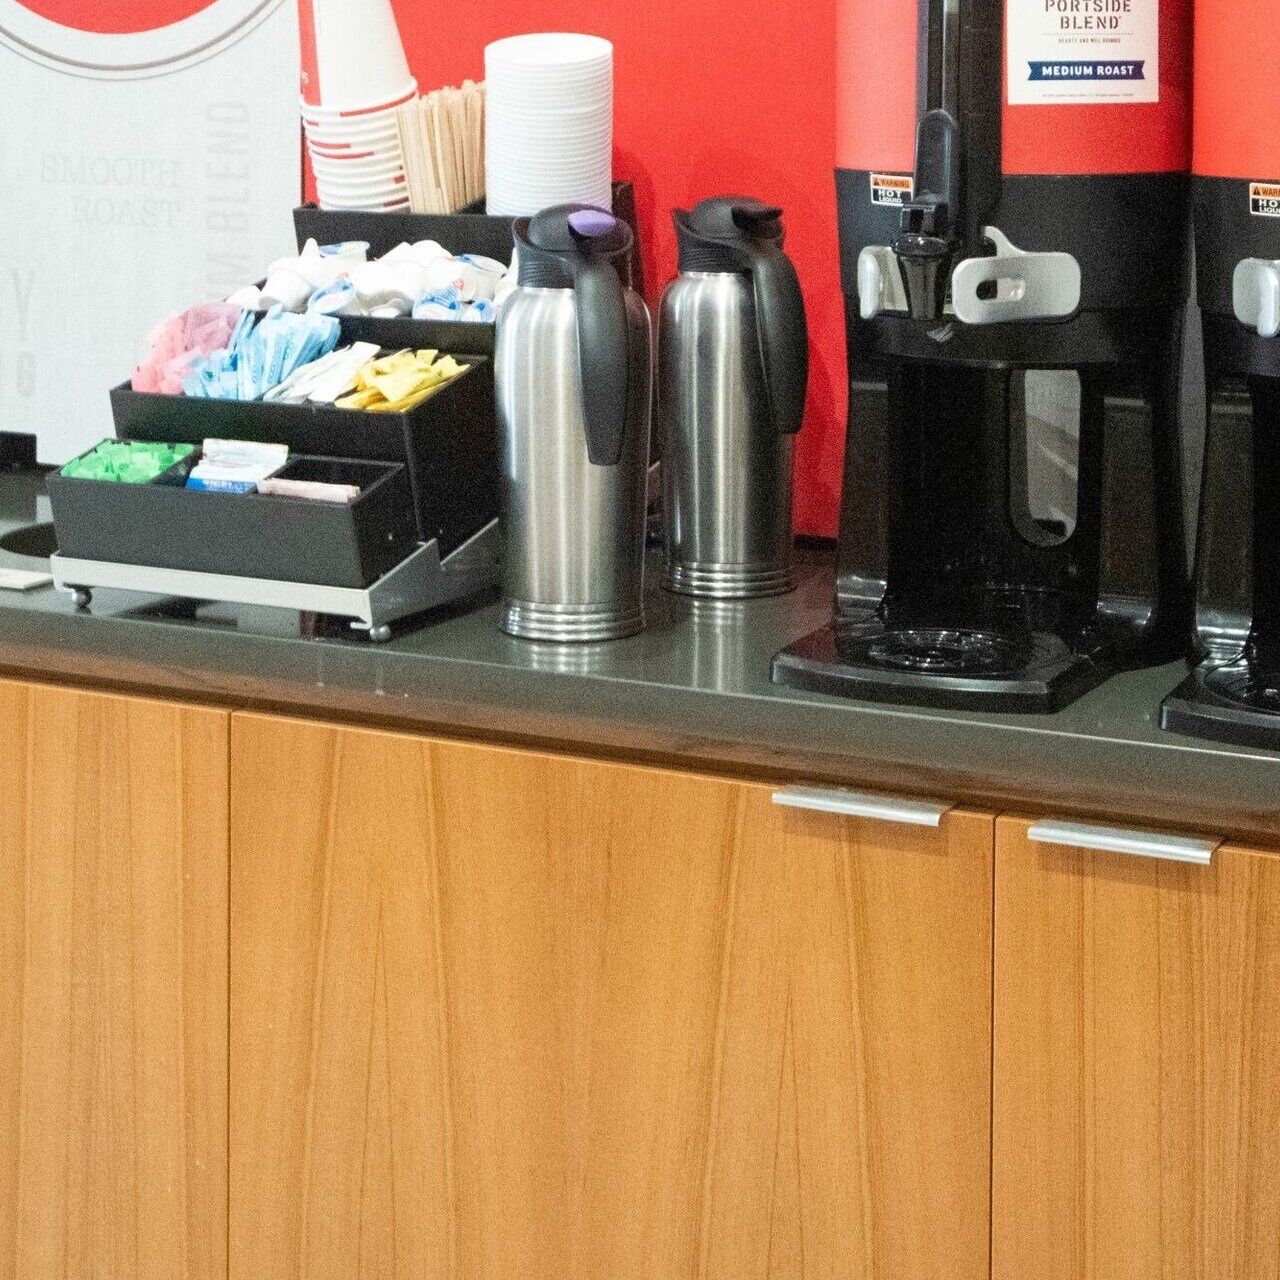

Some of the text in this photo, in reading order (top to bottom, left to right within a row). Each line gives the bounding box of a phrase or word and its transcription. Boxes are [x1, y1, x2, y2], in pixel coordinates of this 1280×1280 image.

[1060, 15, 1120, 30] BLEND
[1042, 65, 1135, 76] MEDIUM ROAST
[40, 153, 181, 189] SMOOTH
[204, 100, 250, 233] BLEND
[878, 188, 902, 198] HOT
[71, 194, 182, 231] ROAST
